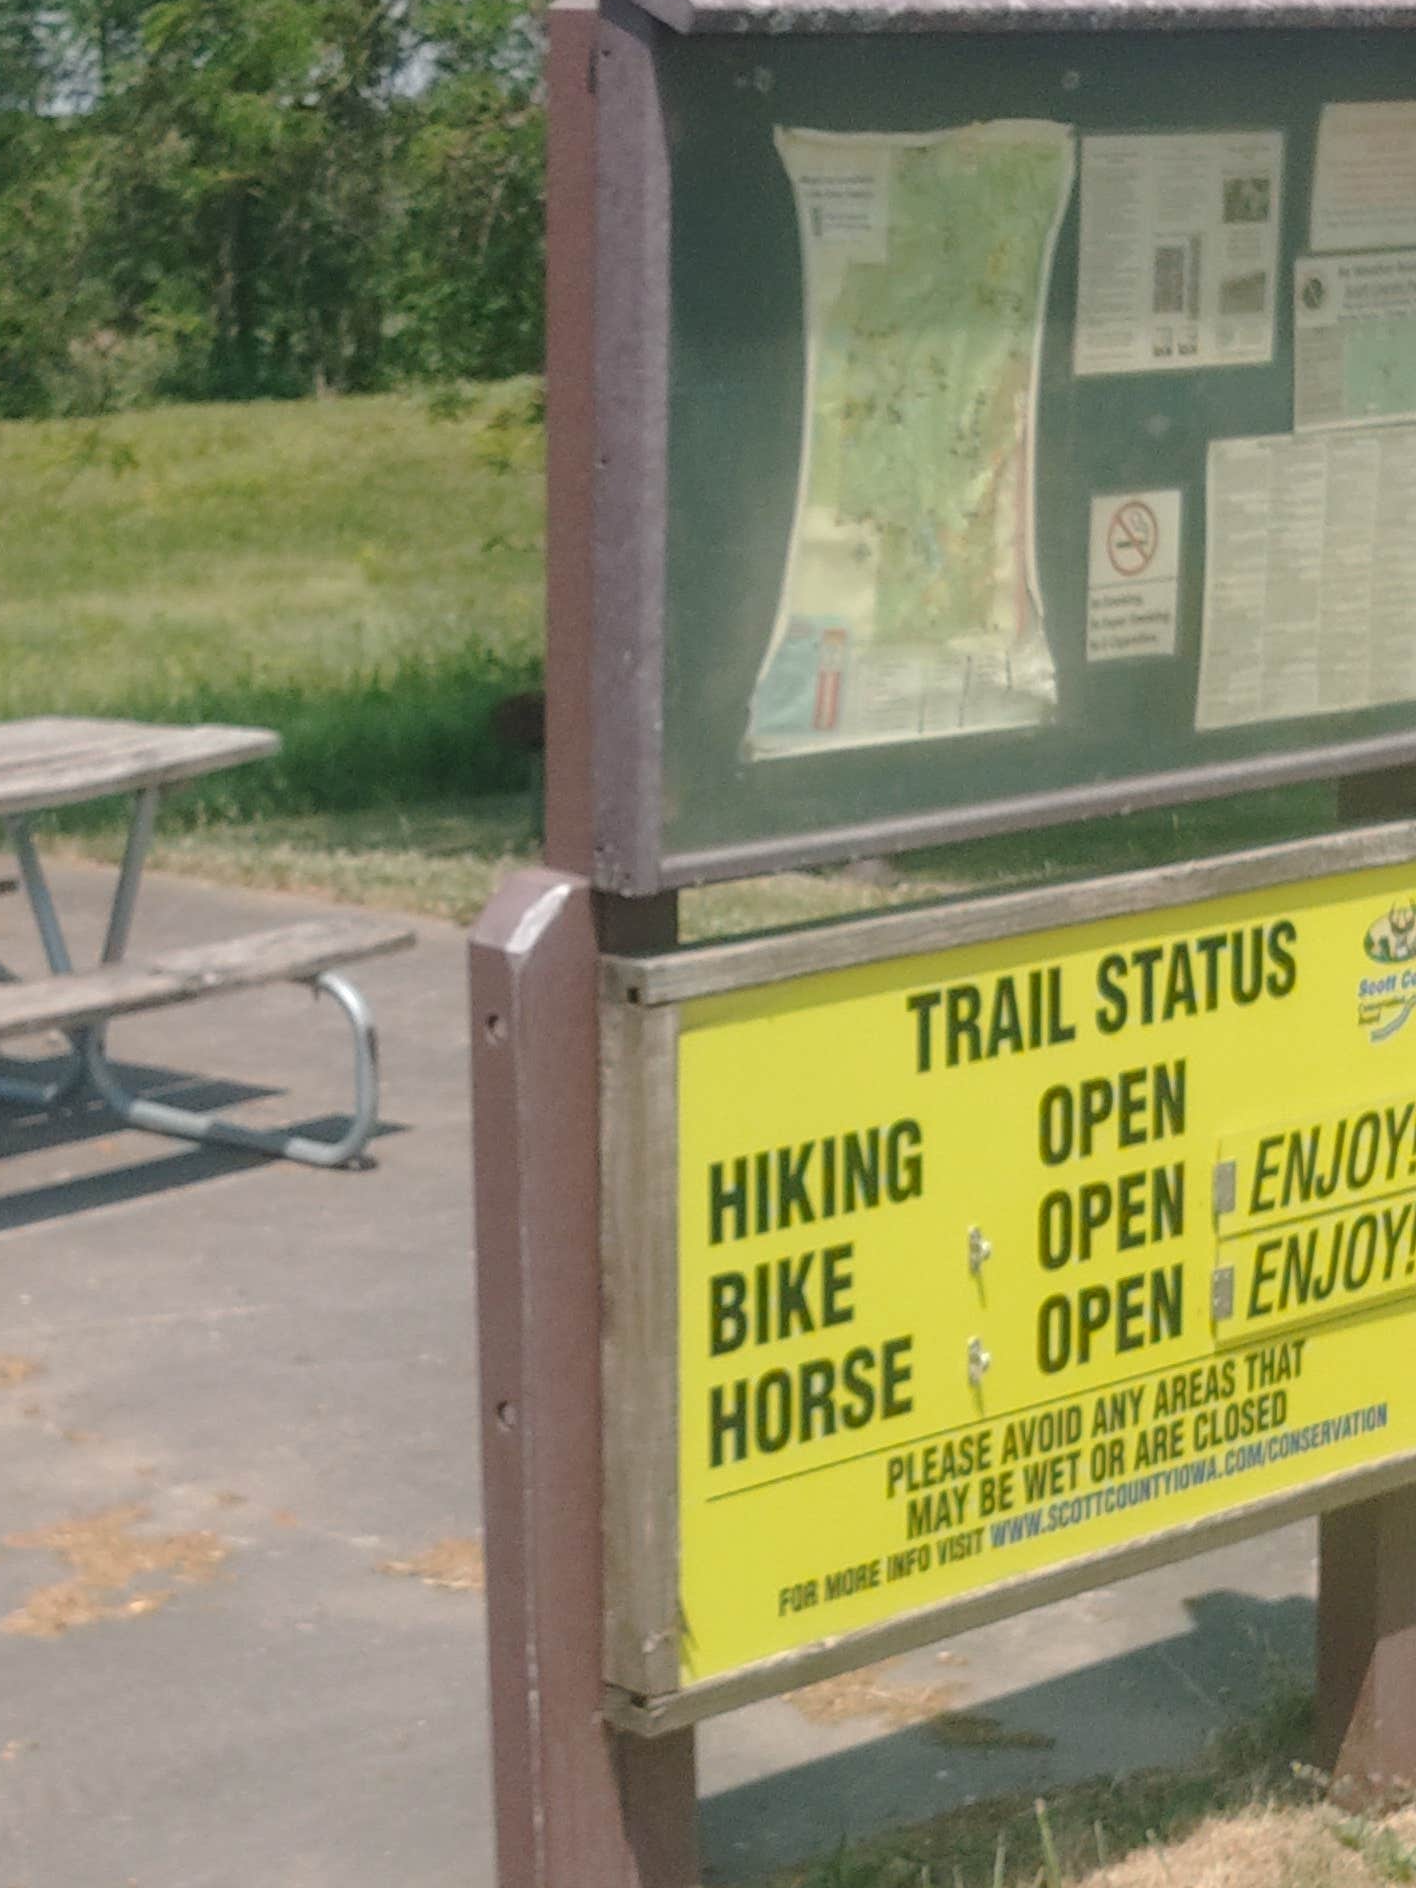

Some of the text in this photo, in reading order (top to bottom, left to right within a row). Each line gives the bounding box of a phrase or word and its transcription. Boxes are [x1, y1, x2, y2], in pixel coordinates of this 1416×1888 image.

[906, 919, 1298, 1074] TRAIL STATUS
[1358, 974, 1397, 997] Scott
[709, 1058, 1186, 1246] HIKING OPEN
[709, 1241, 855, 1358] BIKE
[1038, 1160, 1185, 1271] OPEN
[709, 1334, 913, 1469] HORSE
[1036, 1263, 1184, 1375] OPEN
[885, 1339, 1307, 1498] PLEASE AVOID ANY AREAS THAT
[777, 1402, 1388, 1616] FOR MORE INFO VISIT WWW.SCOTTCOUNTYIOWA.COM/CONSERVATION
[906, 1390, 1288, 1540] MAY BE WET OR ARE CLOSED
